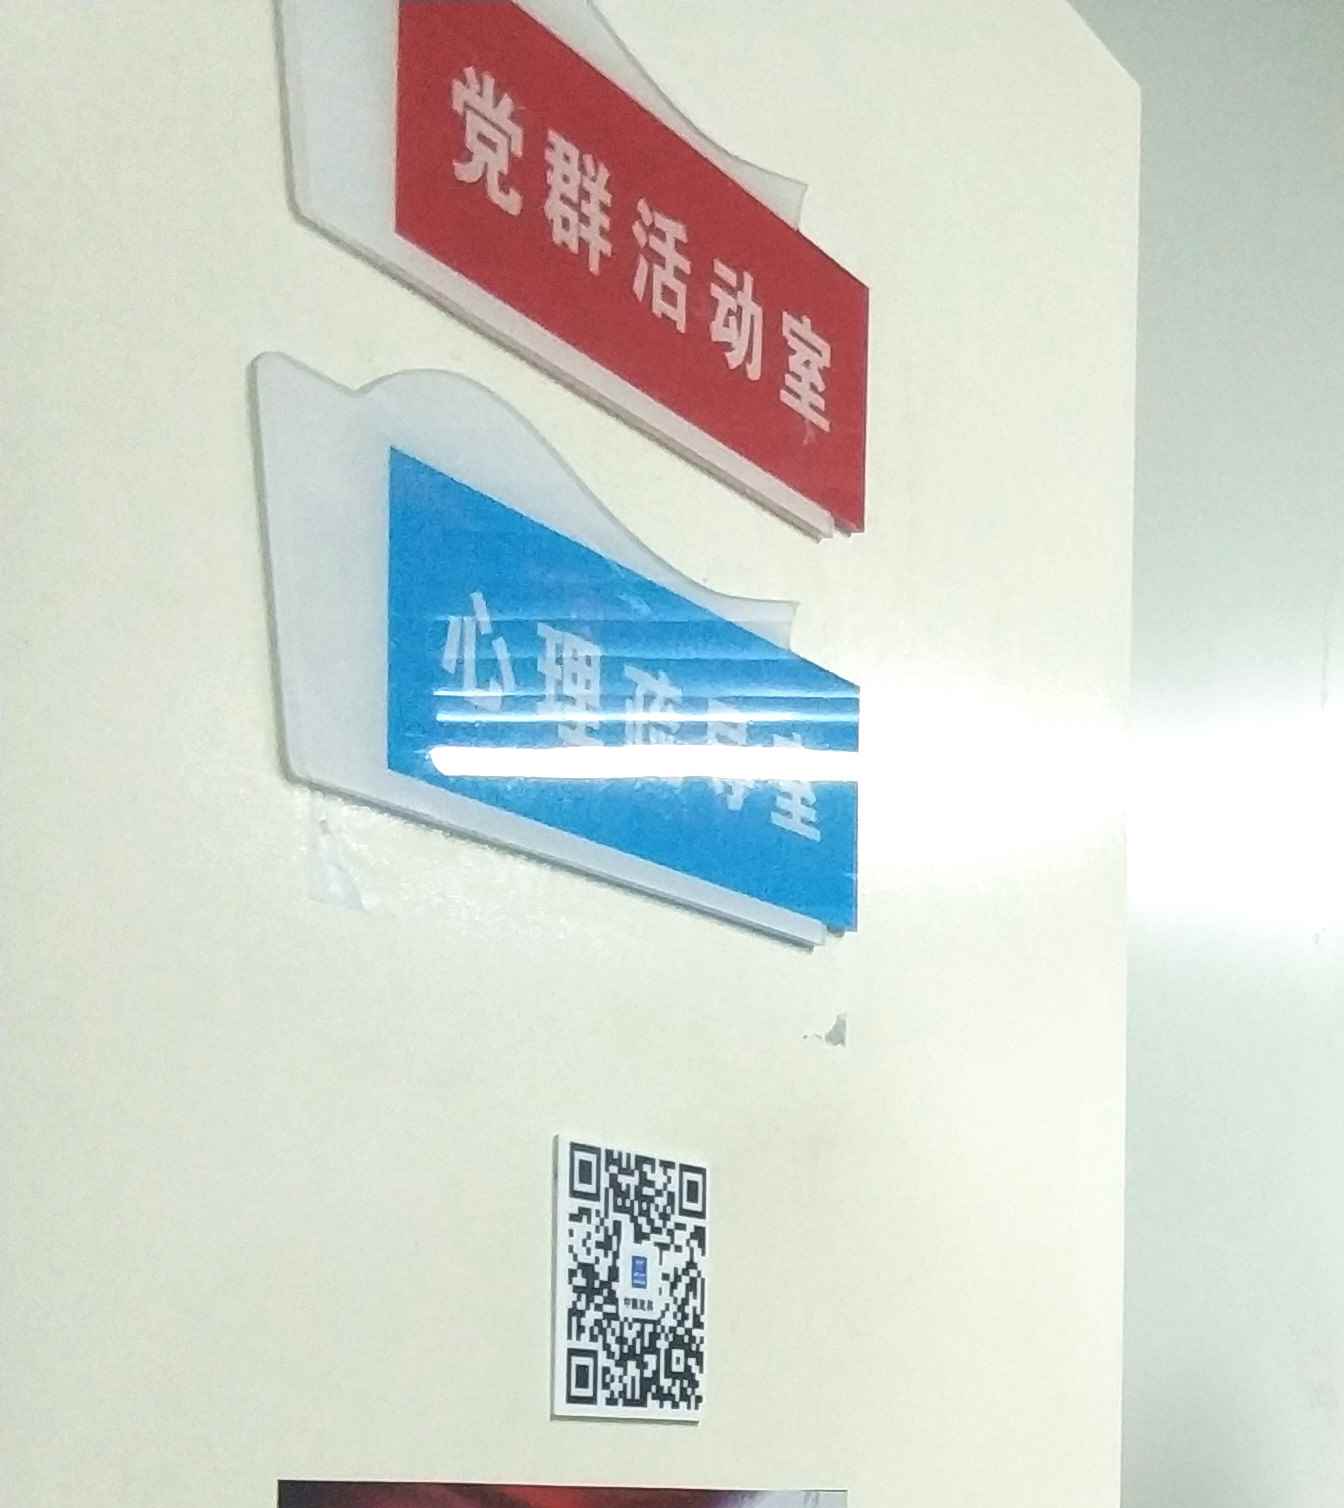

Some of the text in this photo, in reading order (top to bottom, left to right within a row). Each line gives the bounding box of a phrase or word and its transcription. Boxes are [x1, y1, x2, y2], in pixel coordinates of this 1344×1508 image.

[449, 65, 833, 434] 党群活动室
